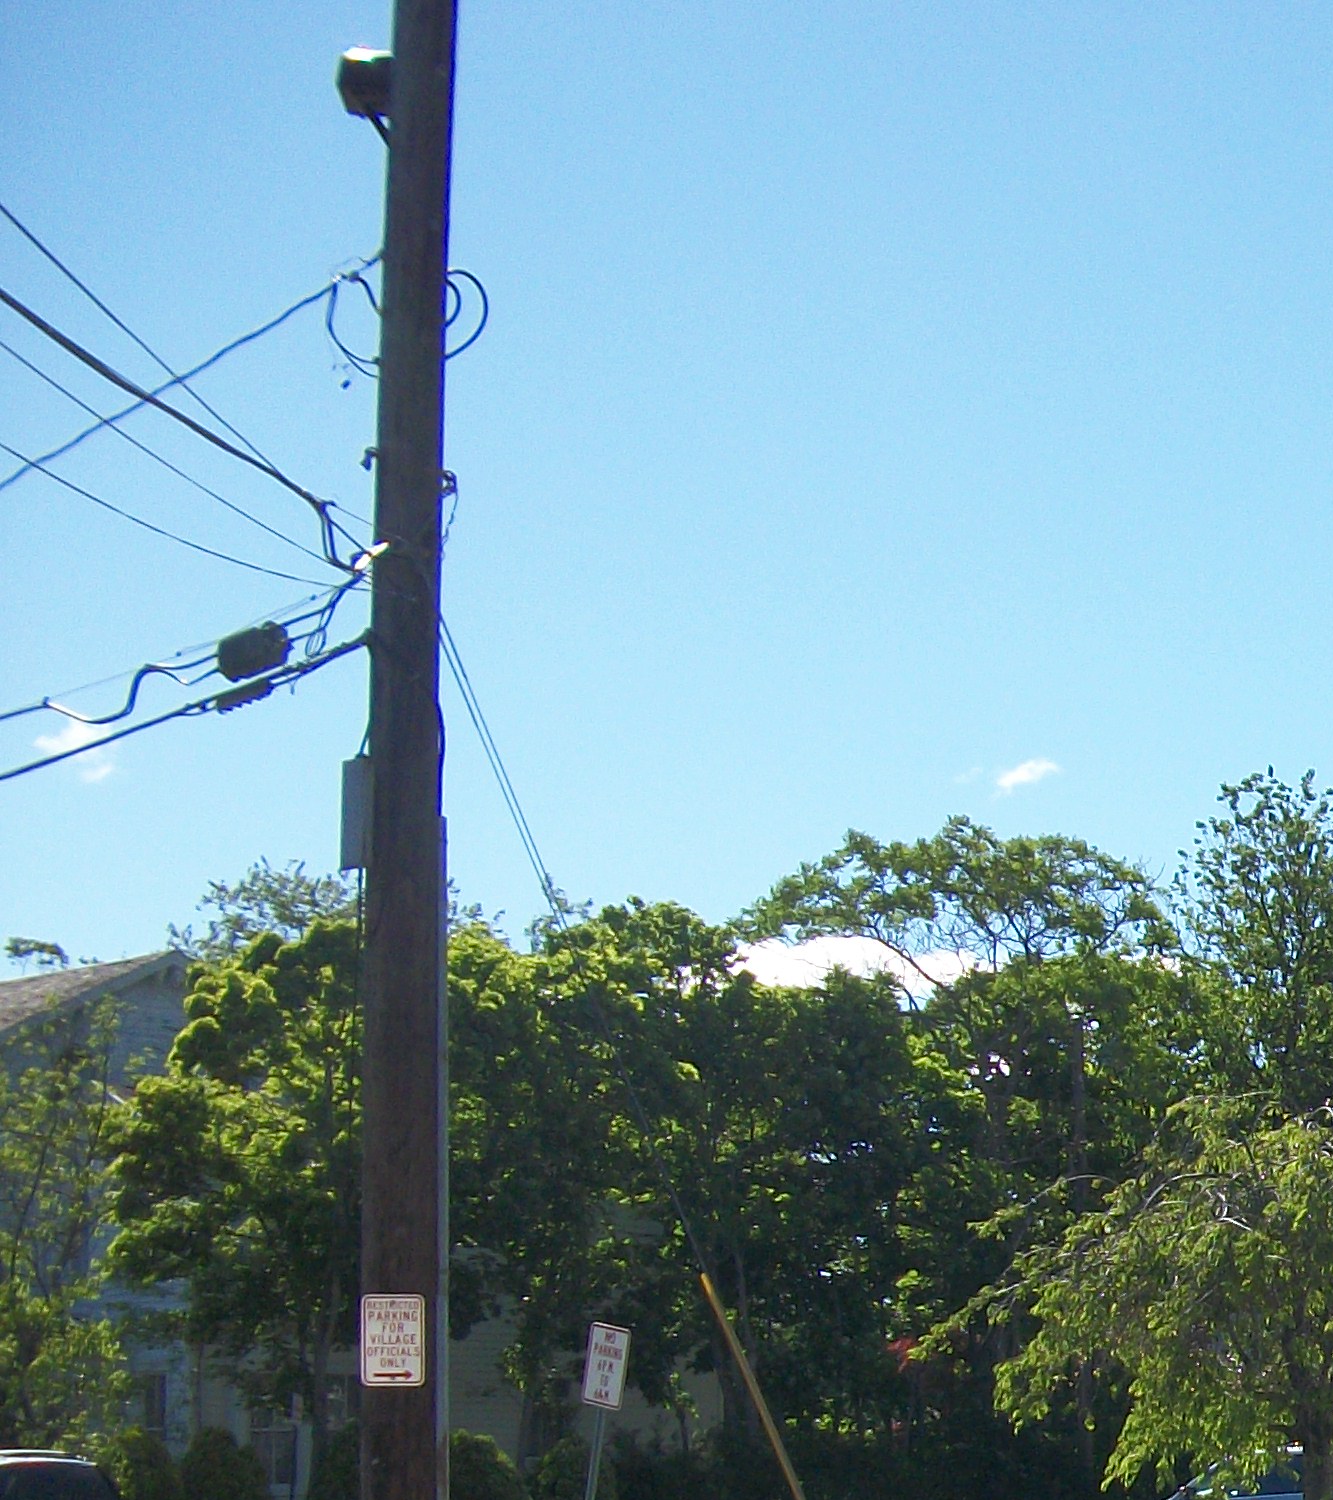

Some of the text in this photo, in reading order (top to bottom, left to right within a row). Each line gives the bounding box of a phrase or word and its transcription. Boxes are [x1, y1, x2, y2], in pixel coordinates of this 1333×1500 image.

[368, 1310, 418, 1321] PARKING
[382, 1322, 405, 1333] FOR
[369, 1333, 417, 1345] VILLAGE
[367, 1346, 420, 1357] OFFICIALS
[380, 1357, 407, 1368] ONLY
